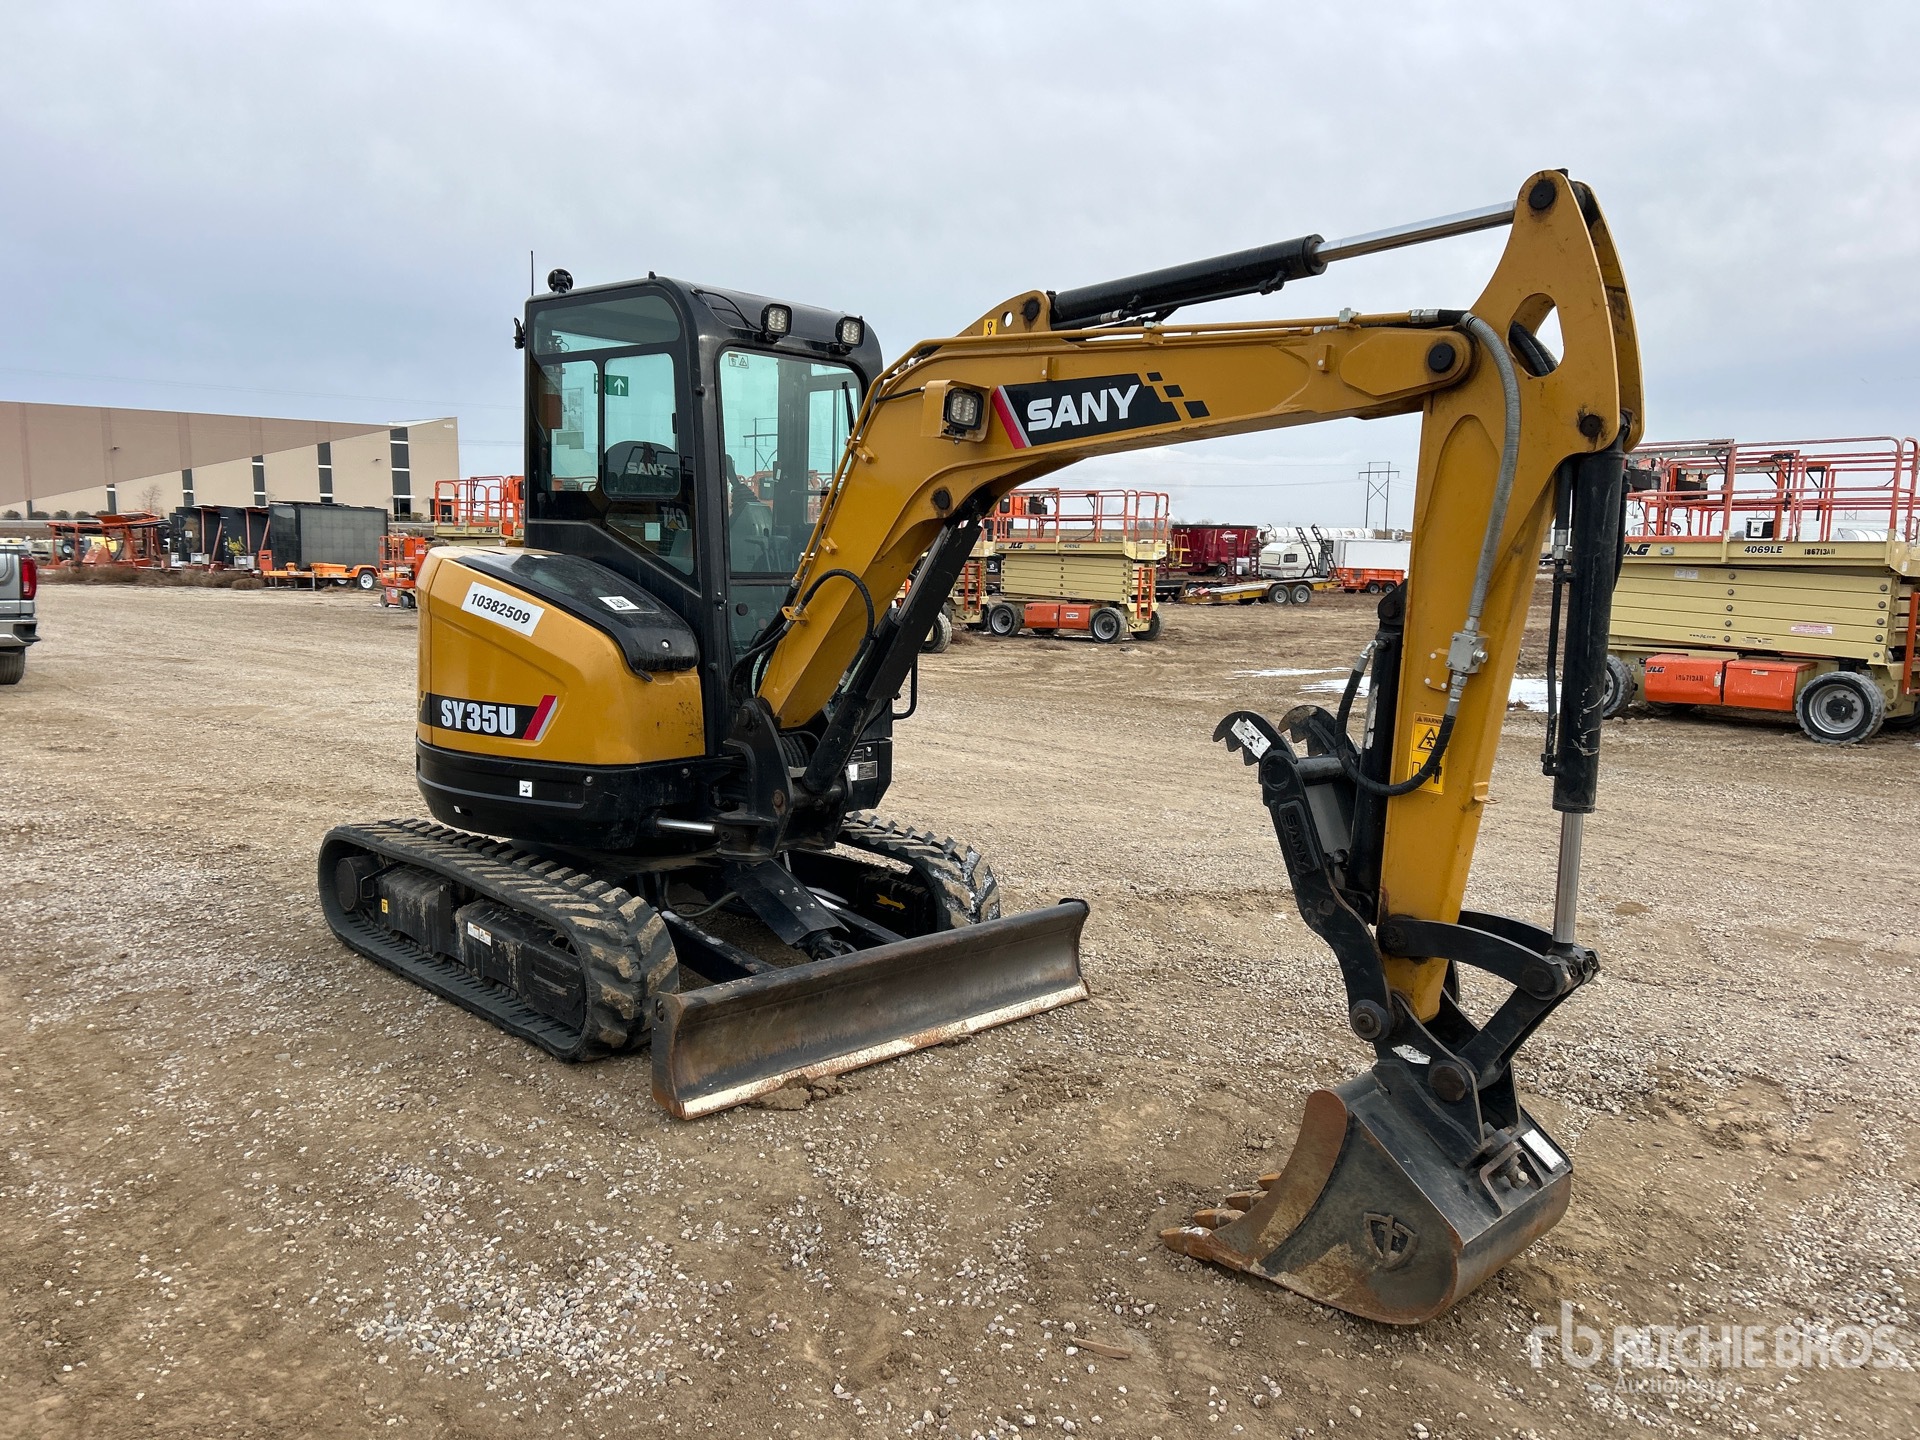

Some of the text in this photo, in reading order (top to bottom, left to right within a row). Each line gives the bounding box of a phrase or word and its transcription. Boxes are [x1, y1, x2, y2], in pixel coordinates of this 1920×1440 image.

[1027, 384, 1140, 432] SANY
[627, 461, 668, 476] SANY
[1744, 545, 1783, 554] 4069LE
[471, 593, 531, 624] 10382509
[441, 699, 516, 735] SY35U
[1284, 812, 1312, 870] SANY
